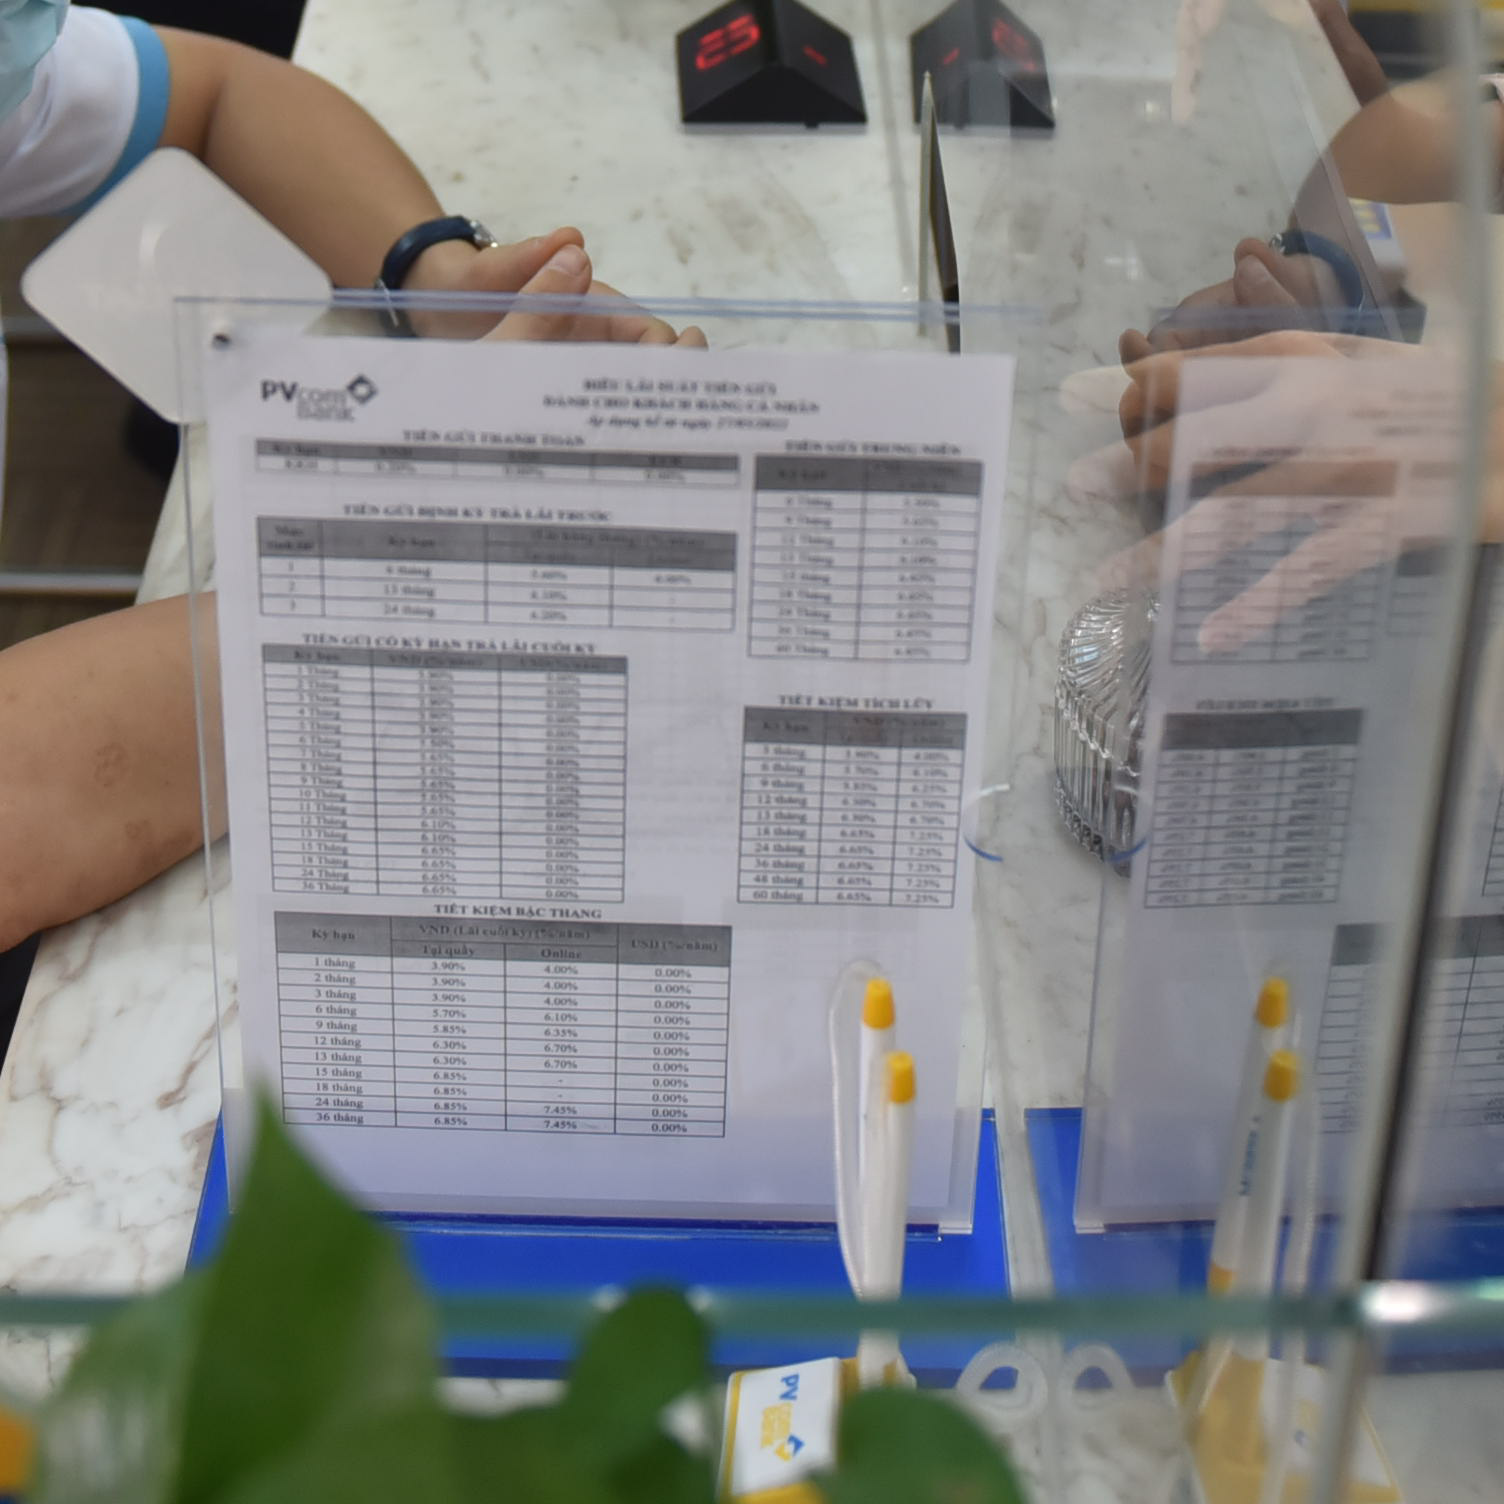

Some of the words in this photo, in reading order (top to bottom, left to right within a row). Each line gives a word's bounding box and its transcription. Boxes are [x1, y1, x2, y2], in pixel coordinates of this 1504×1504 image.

[434, 904, 468, 916] TIẾT
[472, 905, 512, 918] KIỆM
[550, 908, 602, 920] THANG
[541, 948, 582, 959] Online
[313, 957, 321, 966] 1
[324, 957, 356, 969] tháng
[431, 960, 466, 971] 3.90%
[544, 964, 579, 974] 4.00%
[655, 967, 692, 978] 0.00%
[314, 973, 322, 982] 2
[324, 973, 357, 985] tháng
[431, 976, 466, 987] 3.90%
[544, 980, 579, 990] 4.00%
[654, 984, 692, 994] 0.00%
[314, 988, 322, 998] 3
[325, 989, 357, 1001] tháng
[431, 992, 466, 1003] 3.90%
[544, 996, 578, 1006] 4.00%
[654, 999, 691, 1010] 0.00%
[315, 1004, 322, 1014] 6
[325, 1004, 357, 1017] tháng
[431, 1008, 466, 1018] 5.70%
[544, 1011, 578, 1022] 6.10%
[653, 1015, 691, 1025] 0.00%
[315, 1020, 323, 1030] 9
[326, 1020, 358, 1033] tháng
[432, 1024, 466, 1034] 5.85%
[544, 1027, 578, 1038] 6.35%
[653, 1031, 690, 1041] 0.00%
[314, 1036, 327, 1045] 12
[330, 1036, 362, 1048] tháng
[432, 1039, 466, 1050] 6.30%
[544, 1043, 578, 1053] 6.70%
[653, 1046, 690, 1057] 0.00%
[314, 1051, 328, 1061] 13
[330, 1052, 362, 1064] tháng
[432, 1055, 466, 1065] 6.30%
[544, 1058, 578, 1069] 6.70%
[652, 1062, 689, 1072] 0.00%
[315, 1067, 328, 1077] 15
[331, 1068, 363, 1080] tháng
[432, 1071, 467, 1081] 6.85%
[652, 1078, 689, 1088] 0.00%
[315, 1083, 328, 1092] 18
[331, 1083, 363, 1095] tháng
[432, 1086, 467, 1097] 6.85%
[651, 1093, 688, 1104] 0.00%
[316, 1098, 329, 1107] 24
[332, 1098, 363, 1110] tháng
[432, 1101, 467, 1111] 6.85%
[543, 1105, 577, 1115] 7.45%
[651, 1108, 688, 1118] 0.00%
[316, 1113, 329, 1122] 36
[332, 1113, 364, 1125] tháng
[433, 1116, 467, 1126] 6.85%
[543, 1120, 577, 1130] 7.45%
[651, 1123, 687, 1133] 0.00%
[779, 1373, 801, 1401] PV
